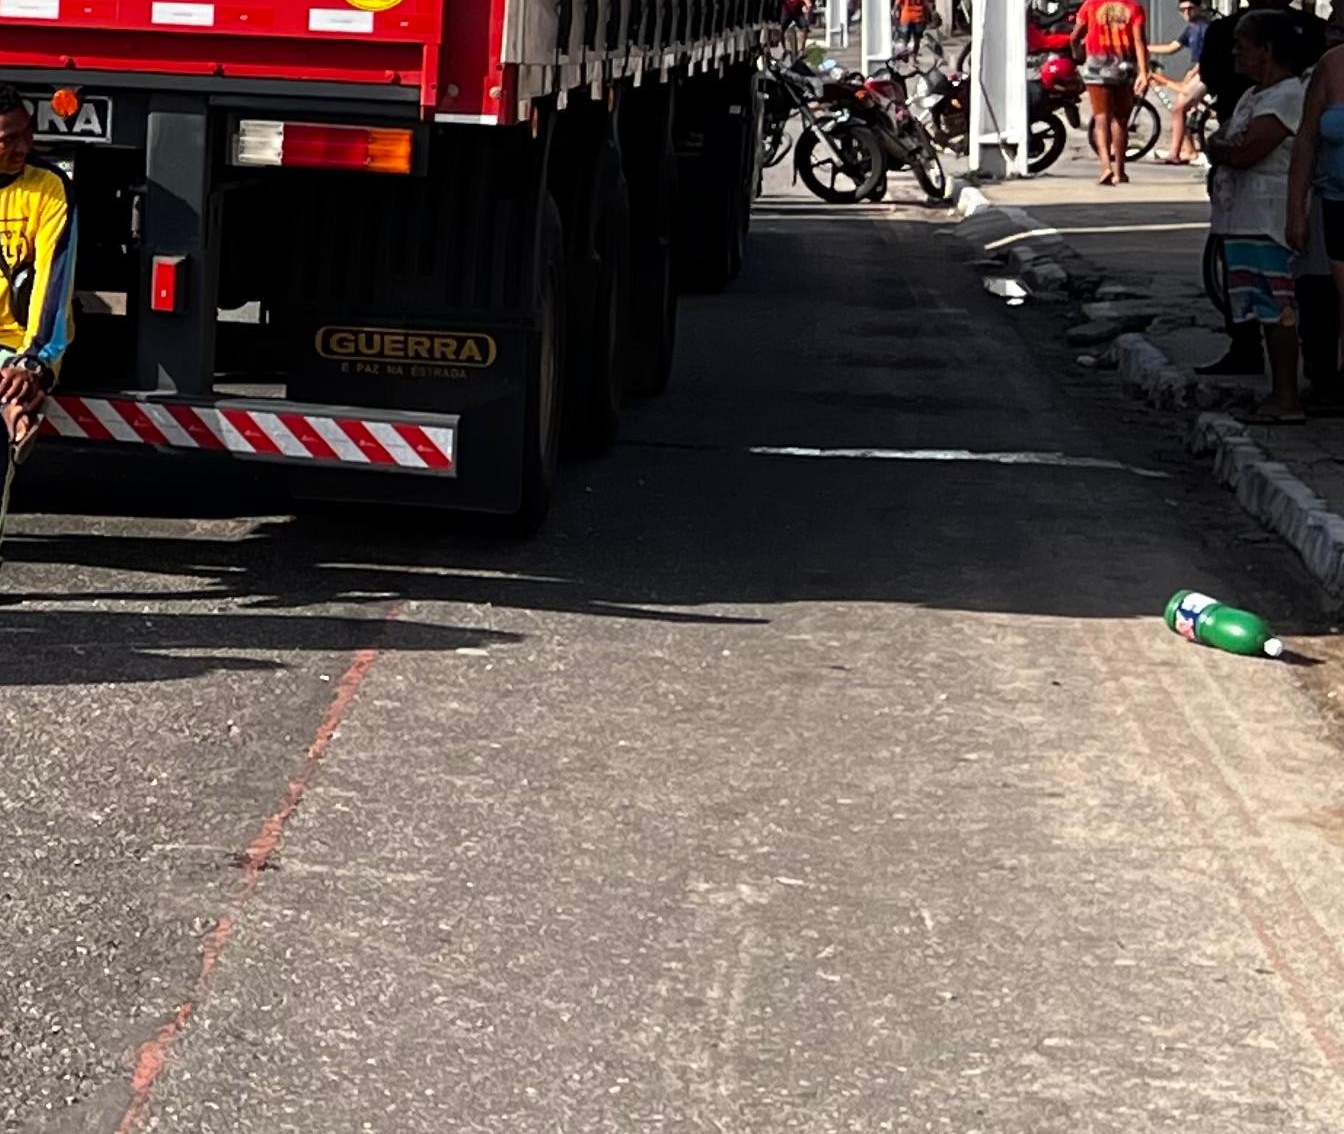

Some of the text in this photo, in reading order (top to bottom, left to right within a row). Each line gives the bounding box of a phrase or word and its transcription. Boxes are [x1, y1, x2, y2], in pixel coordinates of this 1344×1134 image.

[329, 332, 483, 362] GUERRA
[356, 363, 379, 375] PAZ
[387, 365, 404, 376] NA
[410, 364, 468, 380] ESTRADA
